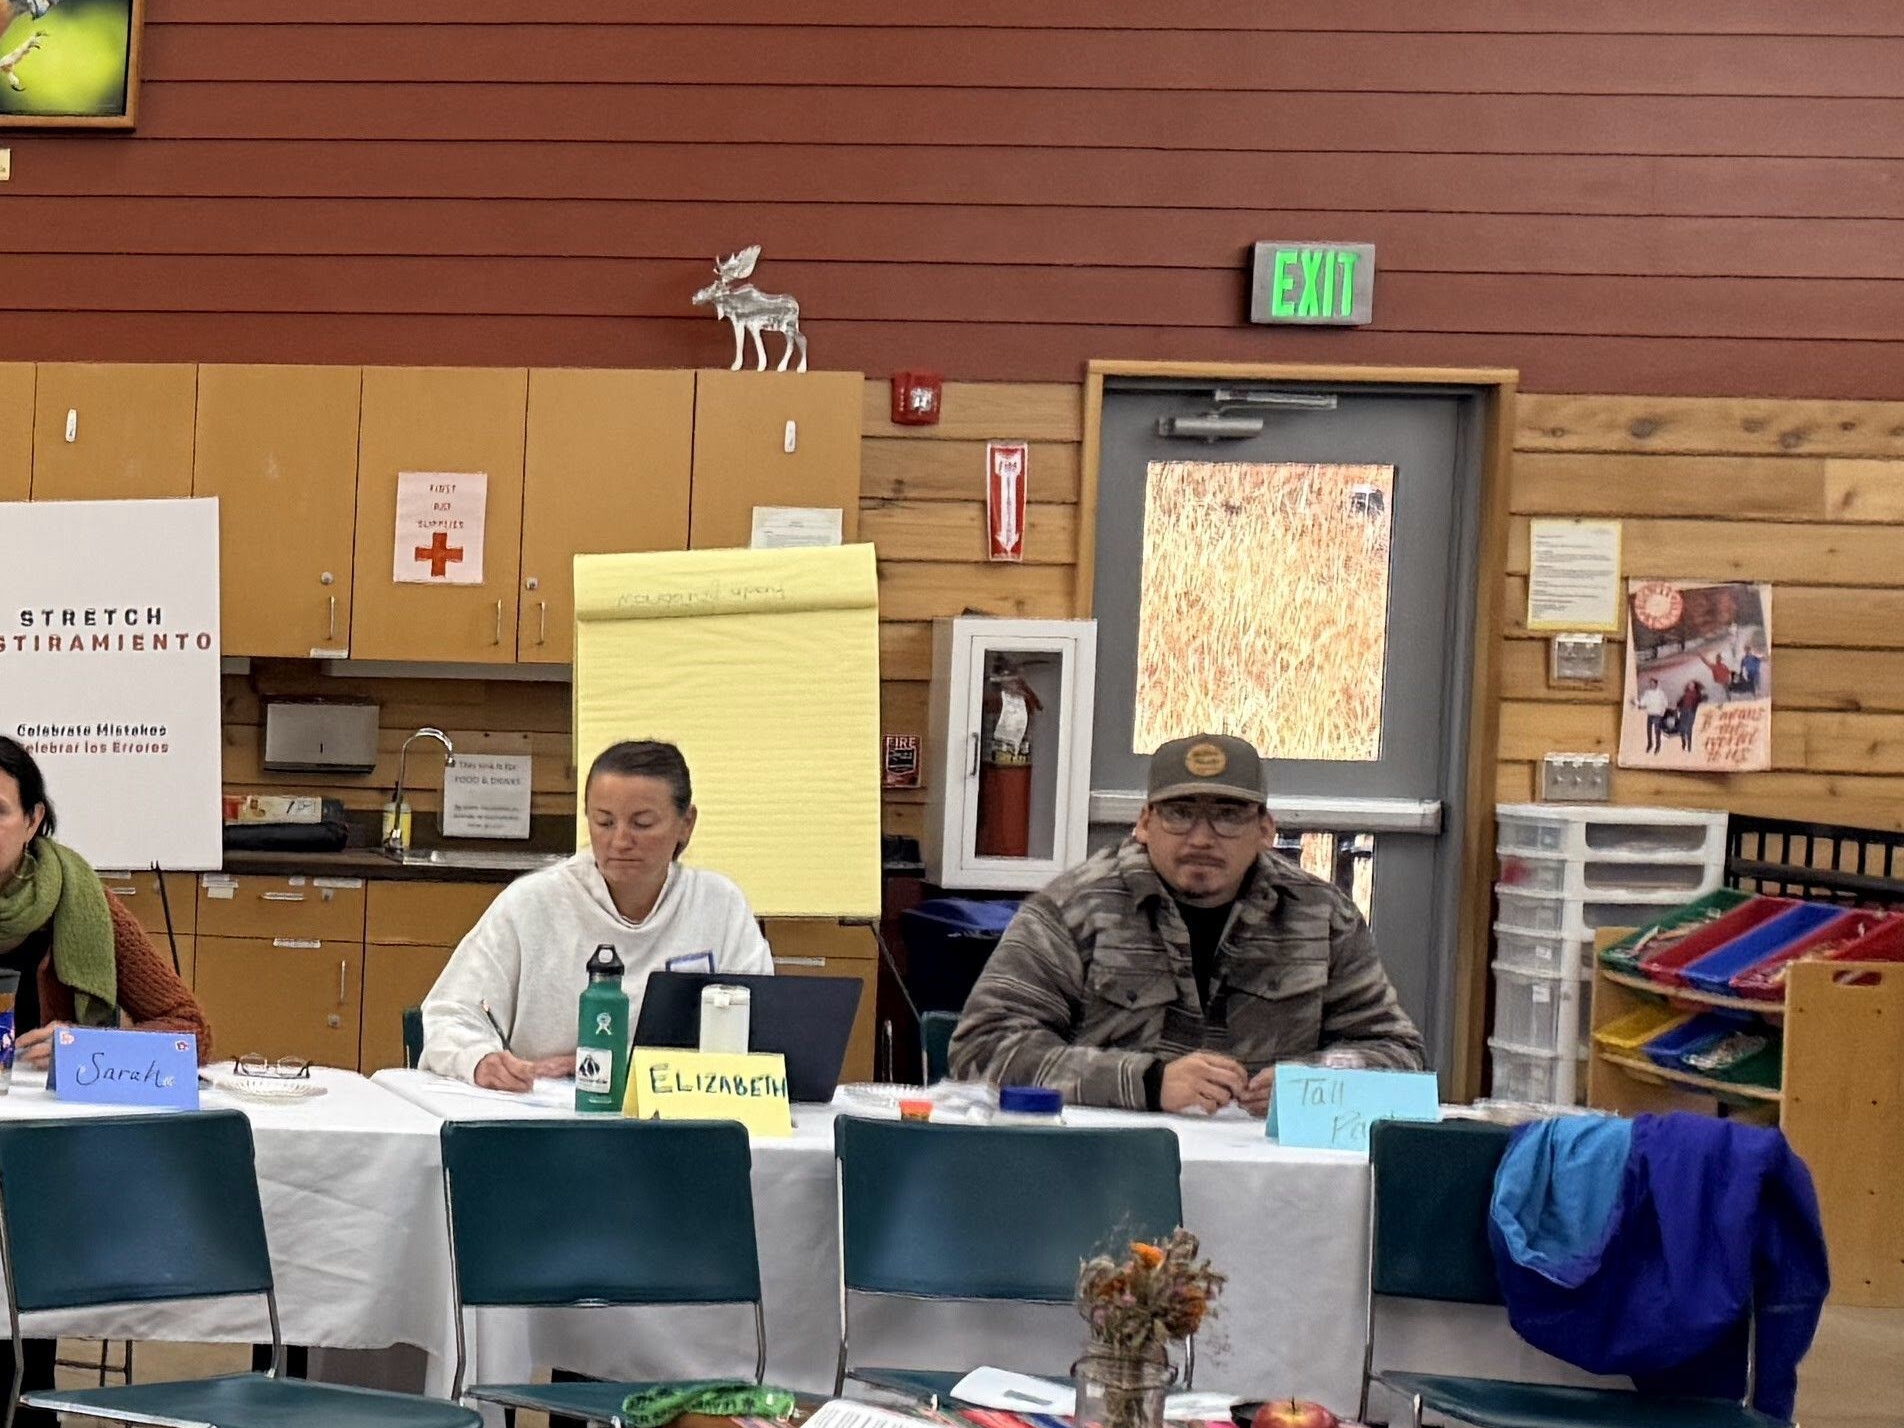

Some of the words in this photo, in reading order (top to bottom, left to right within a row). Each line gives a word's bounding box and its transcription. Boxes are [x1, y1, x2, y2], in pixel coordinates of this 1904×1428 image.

[1272, 250, 1360, 317] EXIT
[20, 607, 162, 627] STRETCH
[16, 723, 91, 737] Celebrate
[96, 723, 167, 737] Mistakes
[886, 736, 916, 748] FIRE
[84, 741, 107, 754] los
[112, 742, 169, 754] Errores
[76, 1052, 164, 1088] Sarah
[649, 1062, 787, 1100] ELIZABETH
[1287, 1077, 1344, 1106] Tall
